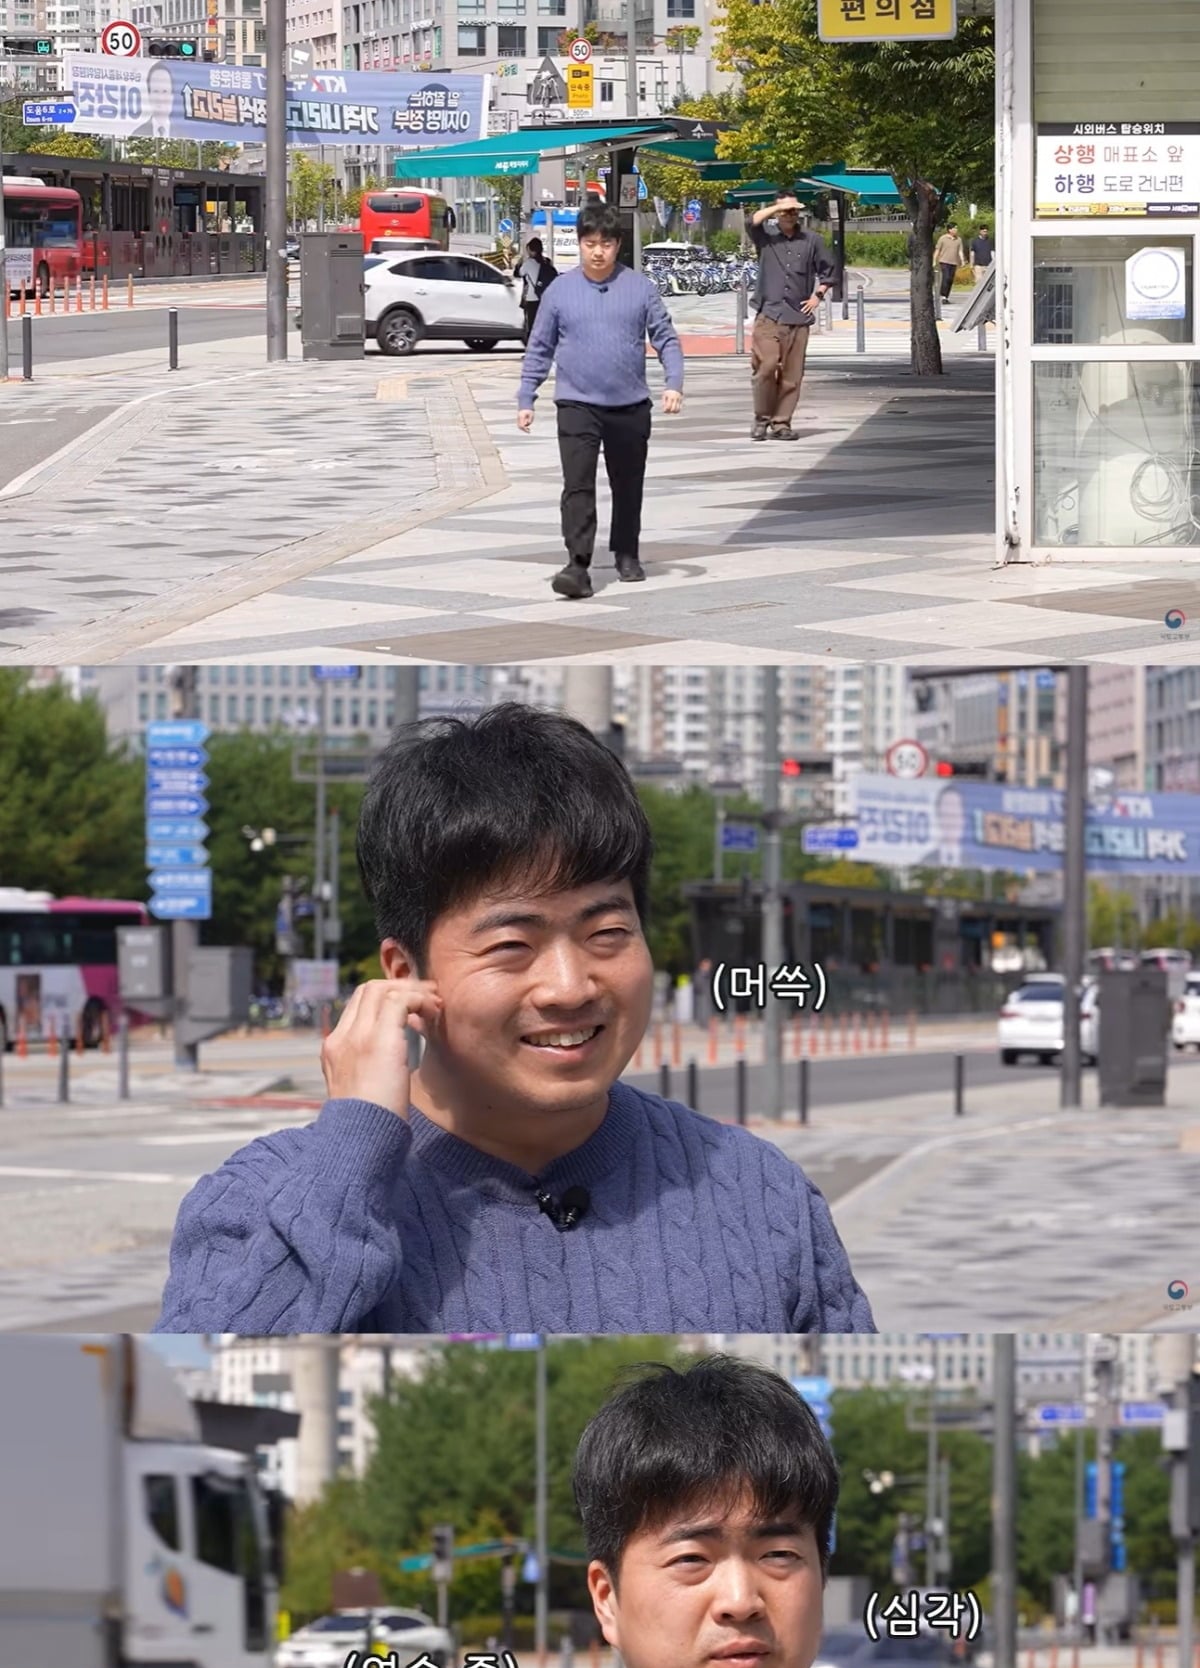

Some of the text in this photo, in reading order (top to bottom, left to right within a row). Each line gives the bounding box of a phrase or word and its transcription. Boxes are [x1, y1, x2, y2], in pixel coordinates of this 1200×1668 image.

[110, 32, 132, 50] 50
[574, 45, 588, 57] 50
[1073, 123, 1165, 135] 시외버스 탑승위치
[1054, 144, 1185, 165] 상행 매표소 앞
[1054, 174, 1184, 194] 하행 도로 건너편
